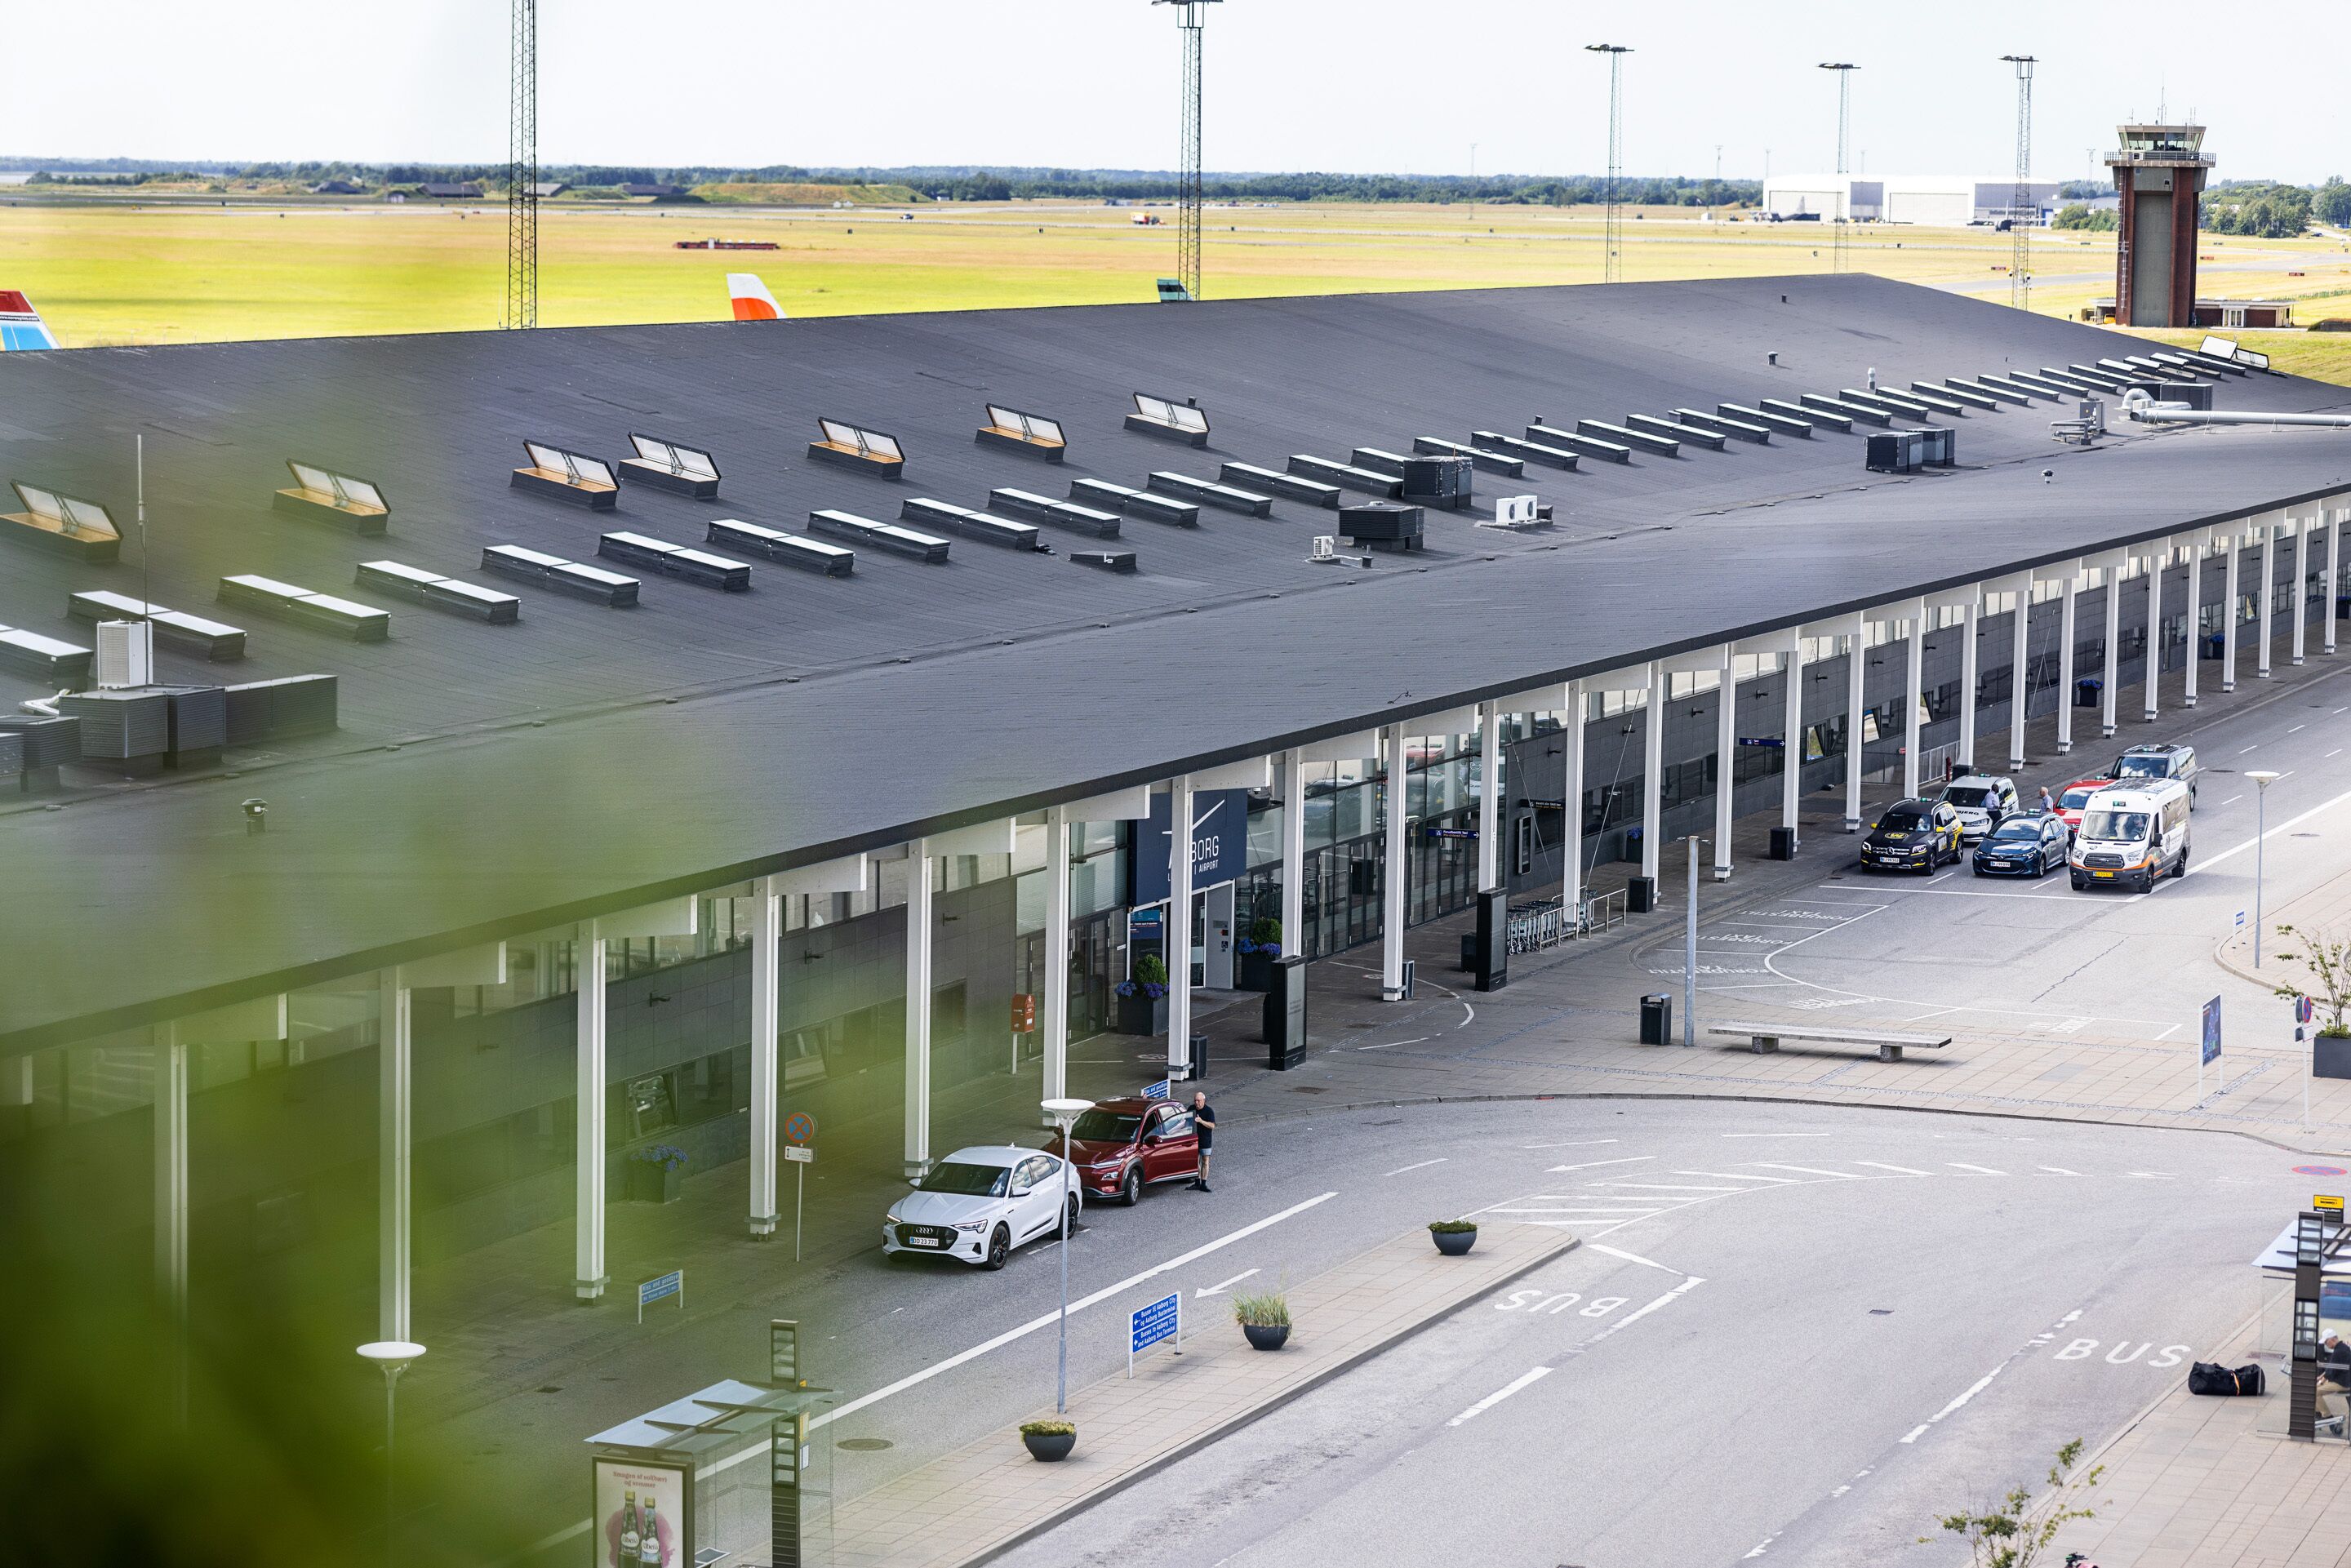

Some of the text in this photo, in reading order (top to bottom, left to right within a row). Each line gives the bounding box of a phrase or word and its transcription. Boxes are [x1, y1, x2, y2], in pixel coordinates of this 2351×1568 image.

[1198, 860, 1219, 873] AIRPORT
[1678, 935, 1793, 944] FORUDBESTIT
[1141, 1308, 1152, 1318] Busser
[1158, 1301, 1169, 1311] Aalborg
[1495, 1290, 1631, 1318] BUS
[1146, 1314, 1158, 1324] Aalborg
[1158, 1305, 1176, 1317] Busterminal
[1141, 1329, 1152, 1339] Busses
[1158, 1321, 1169, 1331] Aalborg
[1144, 1335, 1156, 1344] Aalborg
[1163, 1327, 1176, 1335] Terminal
[2053, 1338, 2191, 1367] BUS
[613, 1471, 636, 1480] Smagen
